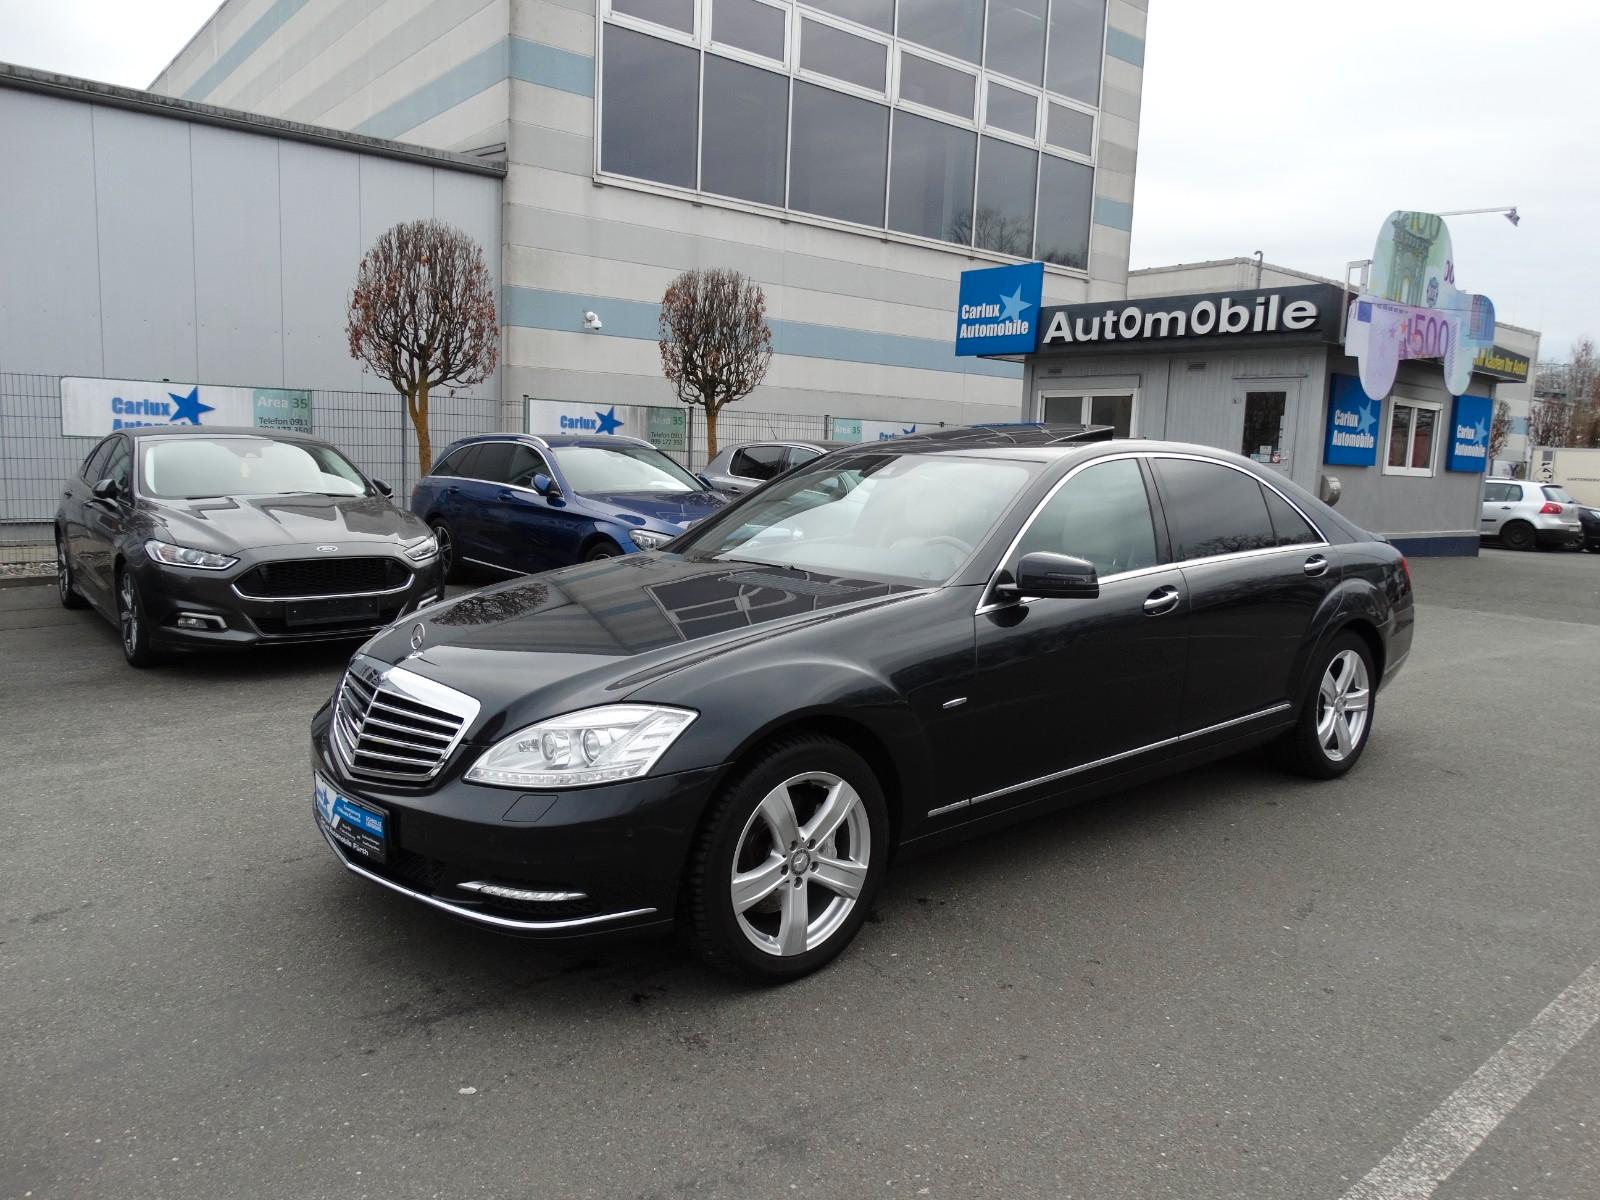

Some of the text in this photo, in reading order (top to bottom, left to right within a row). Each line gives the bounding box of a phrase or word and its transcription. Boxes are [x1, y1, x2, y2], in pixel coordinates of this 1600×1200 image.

[961, 303, 1000, 320] Carlux
[959, 319, 1029, 339] Automobile
[112, 397, 171, 416] Carlux
[257, 396, 308, 409] Area 35
[258, 417, 308, 426] Telefon 0911
[560, 415, 597, 430] Carlux
[672, 416, 683, 425] 35
[1334, 410, 1359, 428] Carlux
[852, 426, 861, 434] 35
[1457, 425, 1474, 439] Carlux
[1332, 430, 1374, 448] Automobile
[1454, 442, 1486, 458] Automobile
